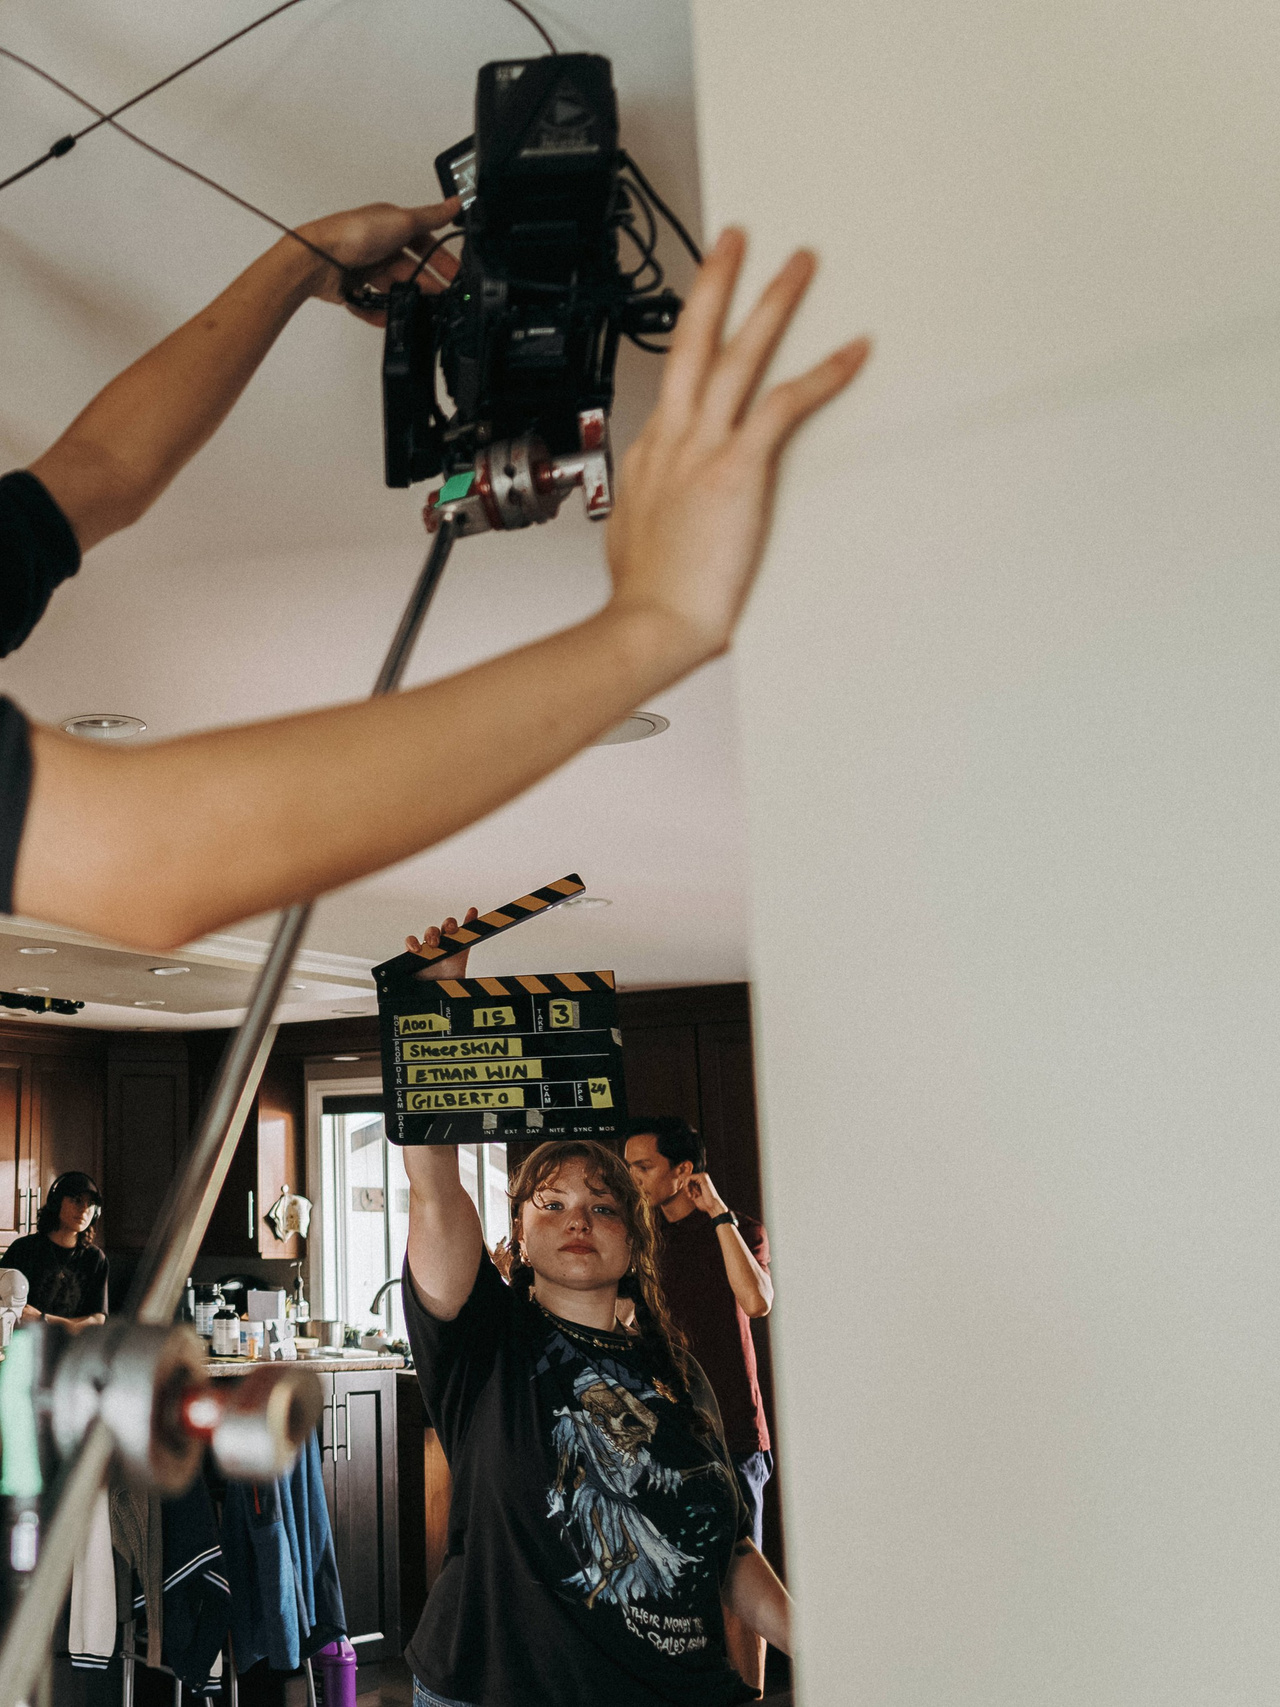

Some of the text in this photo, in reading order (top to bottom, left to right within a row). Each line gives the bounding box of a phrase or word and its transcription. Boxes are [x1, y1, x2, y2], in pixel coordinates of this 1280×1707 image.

[552, 1004, 570, 1024] 3
[402, 1019, 433, 1033] A001
[415, 1064, 528, 1083] ETHAN WIN
[543, 1084, 551, 1104] CAM
[590, 1082, 607, 1096] 24
[396, 1090, 404, 1109] CAM
[397, 1115, 405, 1139] DATE
[629, 1606, 661, 1629] THEIR
